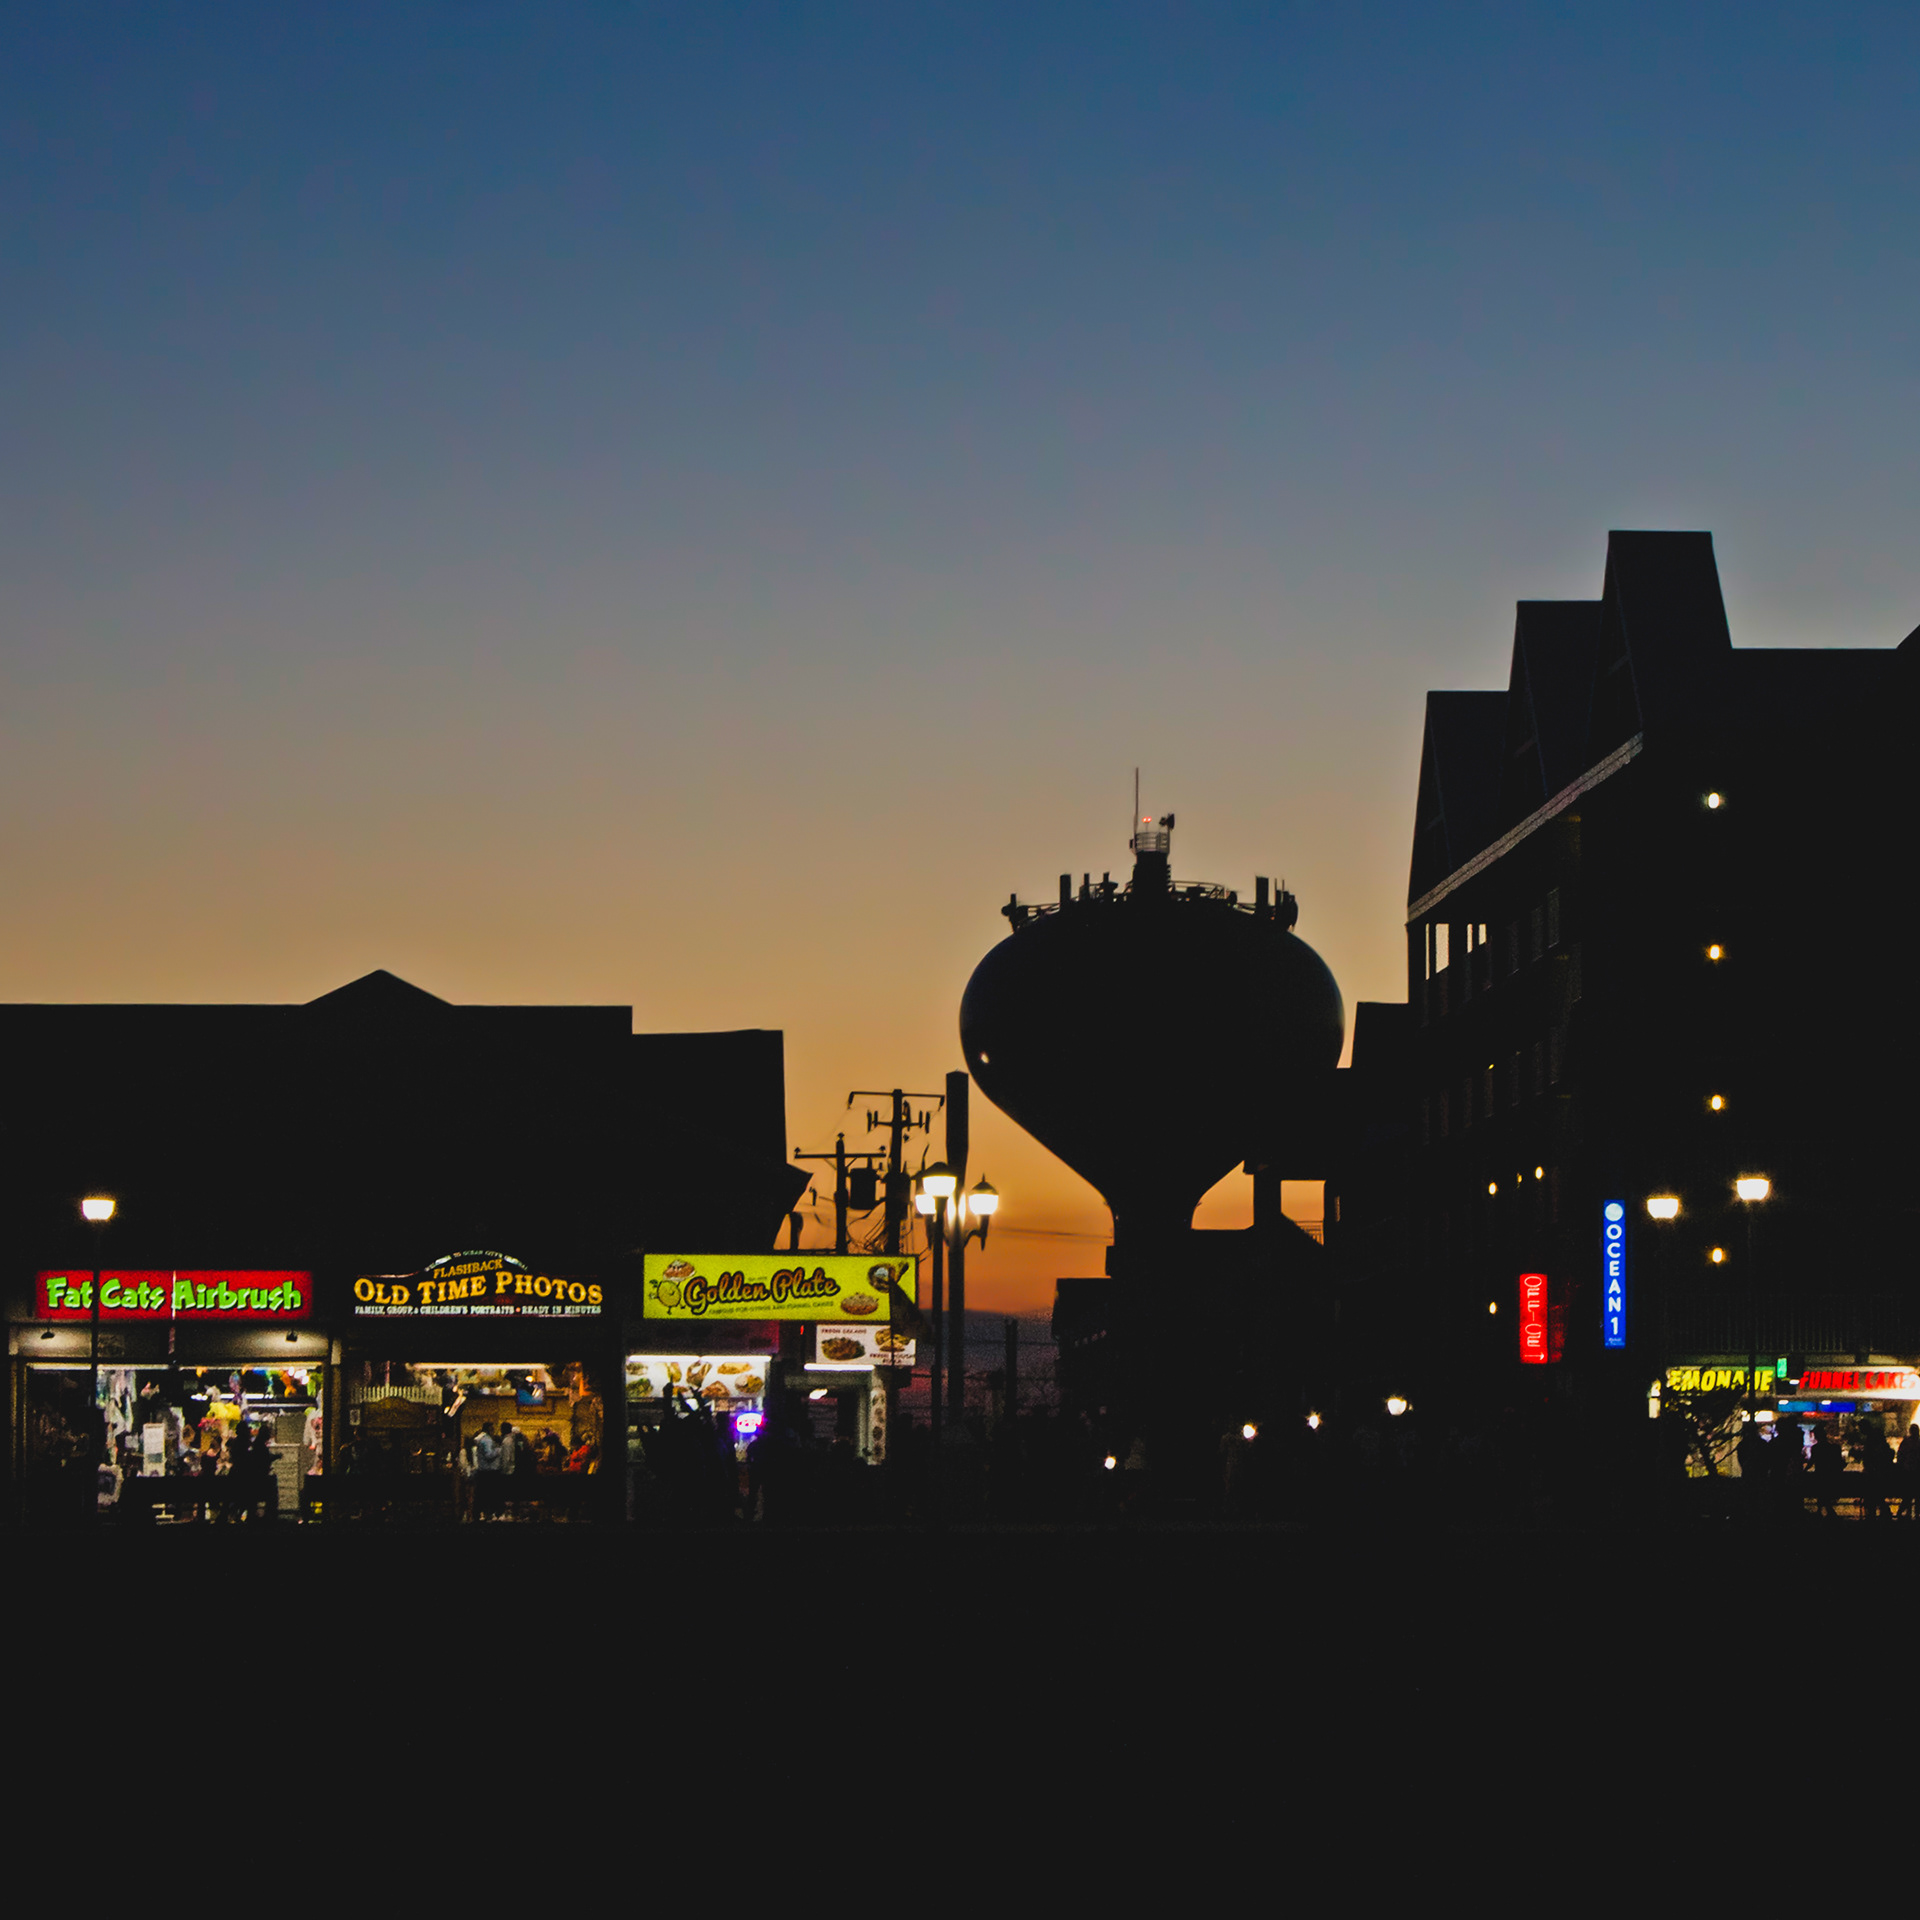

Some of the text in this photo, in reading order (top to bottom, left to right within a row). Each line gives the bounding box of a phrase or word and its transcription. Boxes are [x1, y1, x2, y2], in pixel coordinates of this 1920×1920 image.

[433, 1259, 503, 1279] FLASHBACK
[1606, 1224, 1622, 1312] OCEAN
[46, 1276, 302, 1311] Fat Cats Airbrush
[354, 1271, 603, 1305] OLD TIME PHOTOS
[684, 1267, 841, 1315] Golden Plate
[420, 1305, 468, 1315] CHILDREN'S
[470, 1305, 514, 1315] PORTRAITS
[522, 1305, 549, 1315] READY
[552, 1305, 562, 1315] IN
[565, 1305, 601, 1315] MINUTES
[1524, 1276, 1542, 1347] OFFICE
[1611, 1317, 1619, 1335] 1
[1799, 1371, 1859, 1390] FUNNEL
